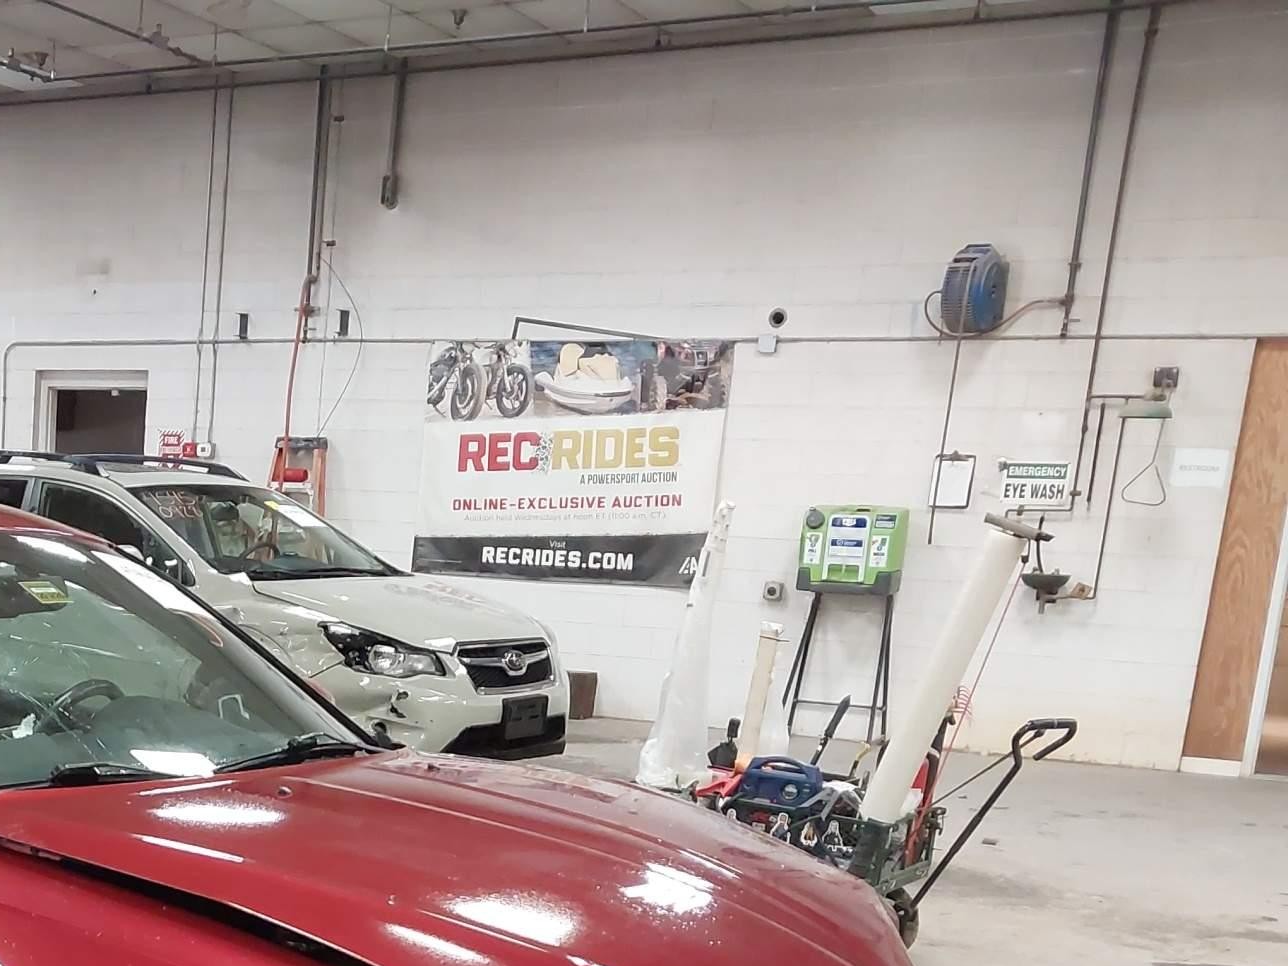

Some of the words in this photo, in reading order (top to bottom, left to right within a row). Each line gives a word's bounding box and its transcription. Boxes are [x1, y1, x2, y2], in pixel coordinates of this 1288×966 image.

[457, 431, 541, 472] REC
[552, 426, 680, 470] RIDES
[580, 474, 586, 485] A
[587, 473, 639, 485] POWERSPORT
[641, 472, 677, 483] AUCTION
[1008, 466, 1066, 477] EMERGENCY
[1003, 483, 1027, 499] EYE
[1030, 483, 1065, 500] WASH
[453, 496, 606, 511] ONLINE-EXCLUSIVE
[611, 494, 682, 509] AUCTION
[549, 540, 566, 549] Visit
[481, 546, 634, 571] RECRIDES.COM
